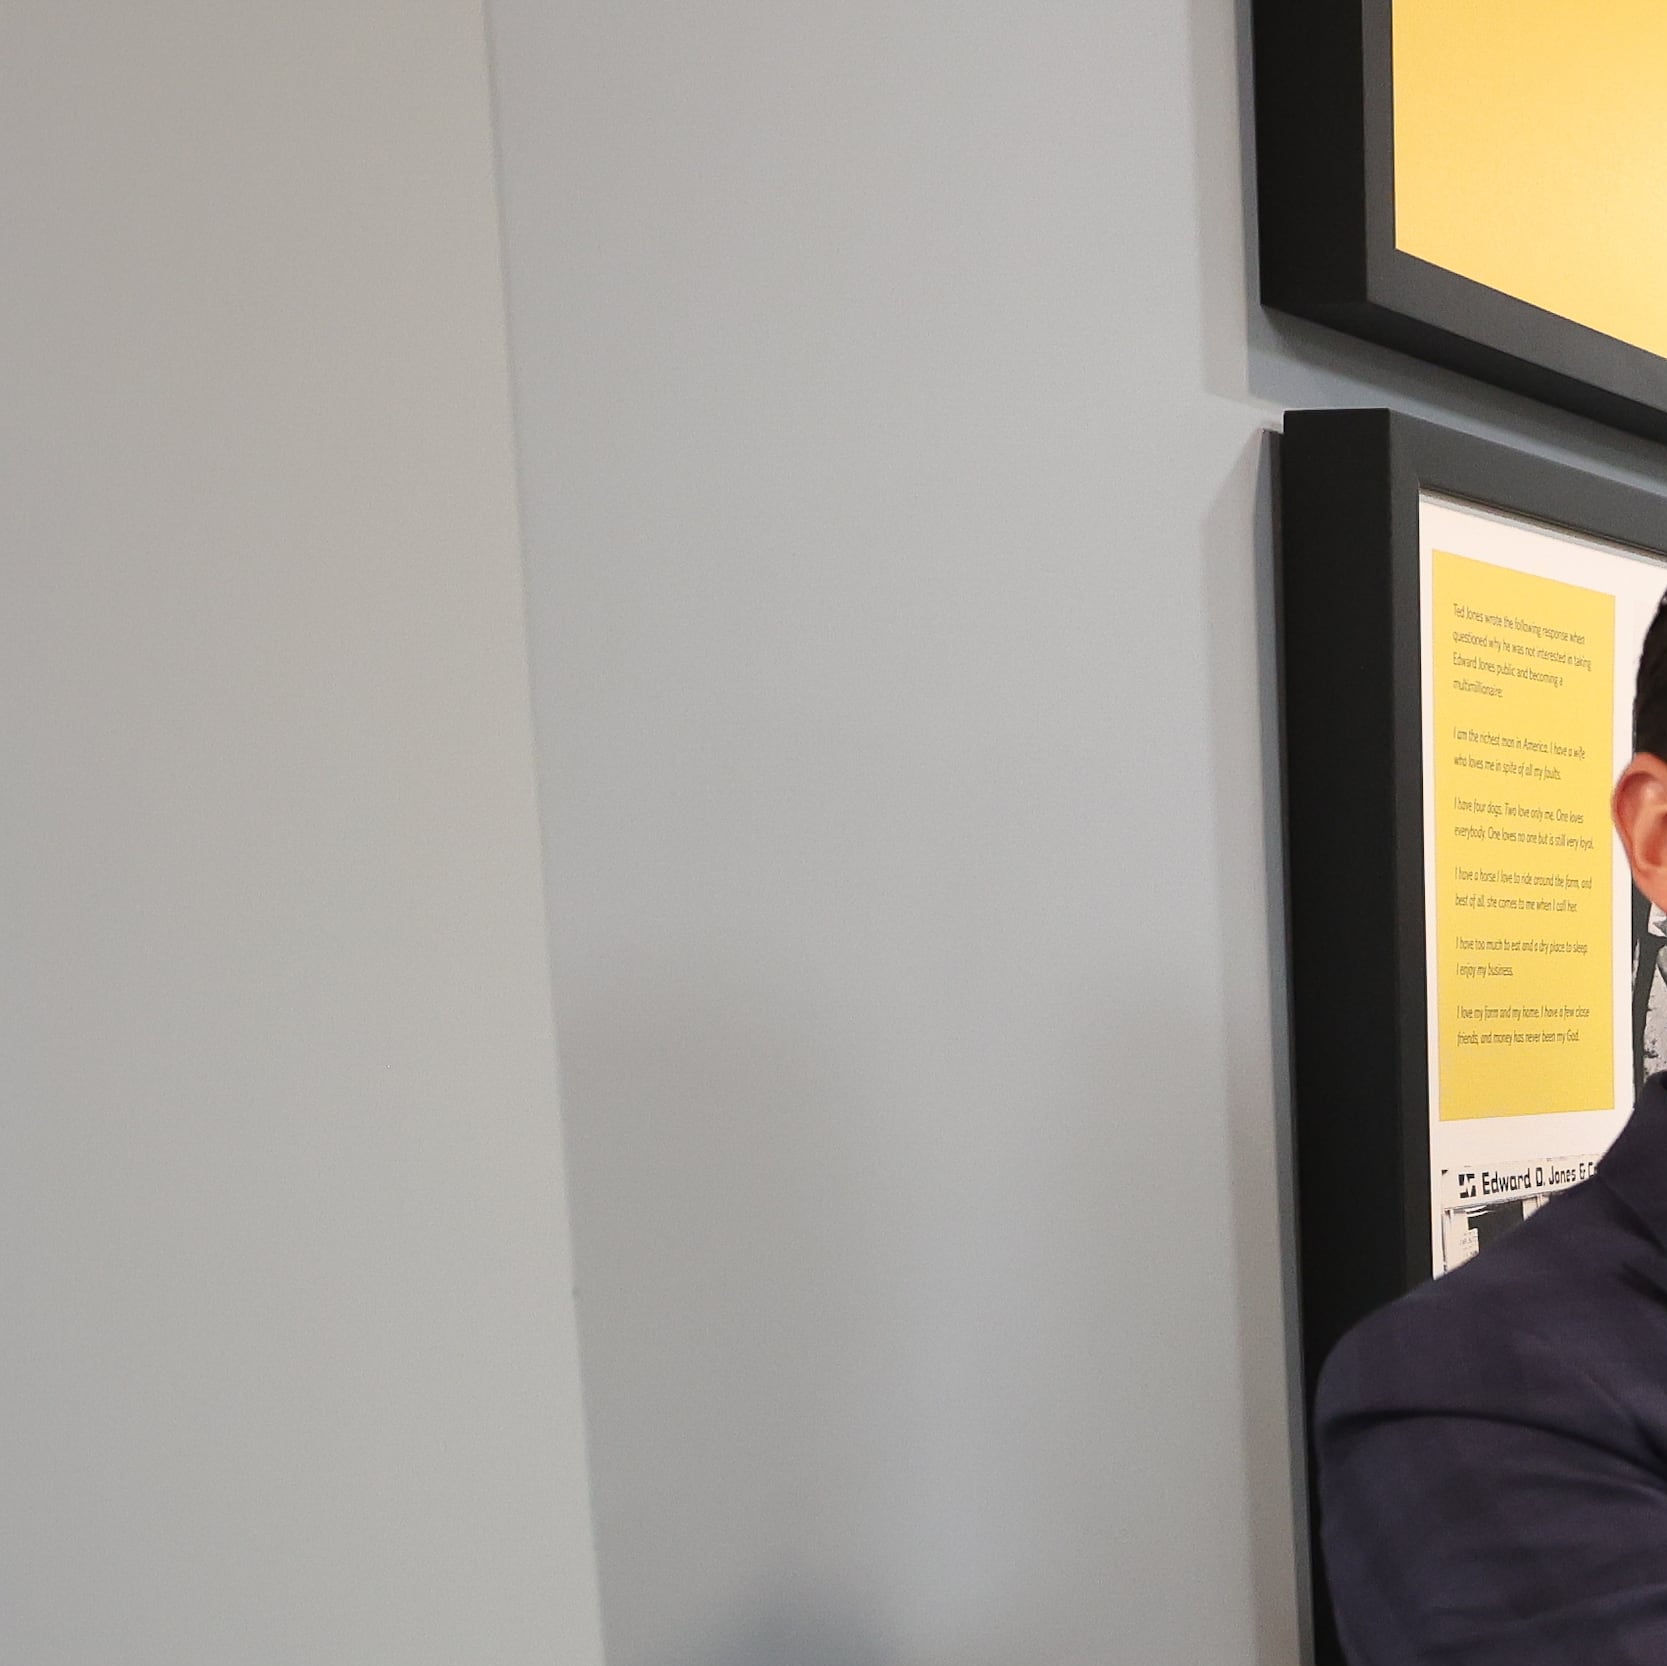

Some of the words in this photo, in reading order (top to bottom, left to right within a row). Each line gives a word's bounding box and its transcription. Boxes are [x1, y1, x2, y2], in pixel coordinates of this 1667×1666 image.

[1481, 1167, 1532, 1195] Edward
[1548, 1165, 1577, 1185] Jones
[1579, 1162, 1586, 1180] &
